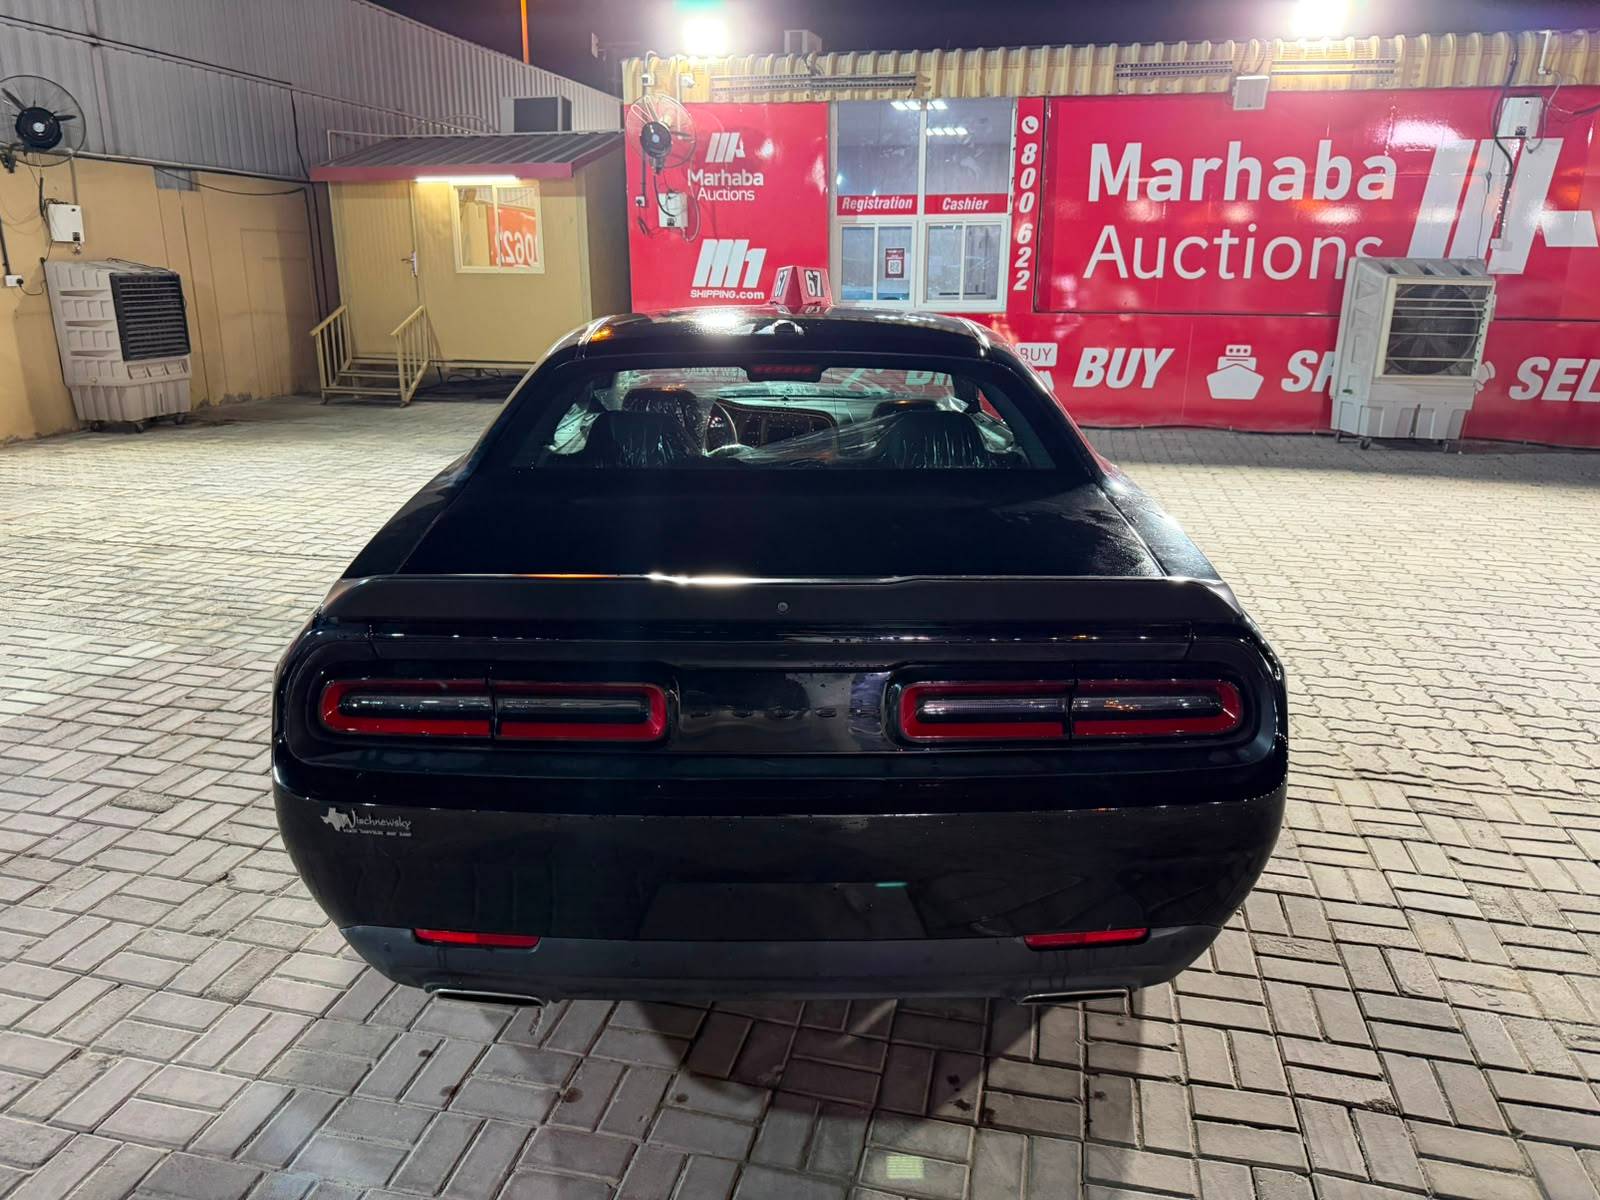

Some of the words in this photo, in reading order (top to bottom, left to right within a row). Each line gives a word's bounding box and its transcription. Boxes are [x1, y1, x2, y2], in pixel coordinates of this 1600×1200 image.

[687, 169, 764, 186] Marhaba
[1088, 139, 1396, 201] Marhaba
[697, 187, 755, 201] Auctions
[842, 196, 913, 211] Registration
[942, 197, 989, 211] Cashier
[805, 271, 821, 297] 67
[690, 289, 765, 299] SHIPPING.com
[1073, 347, 1174, 389] BUY
